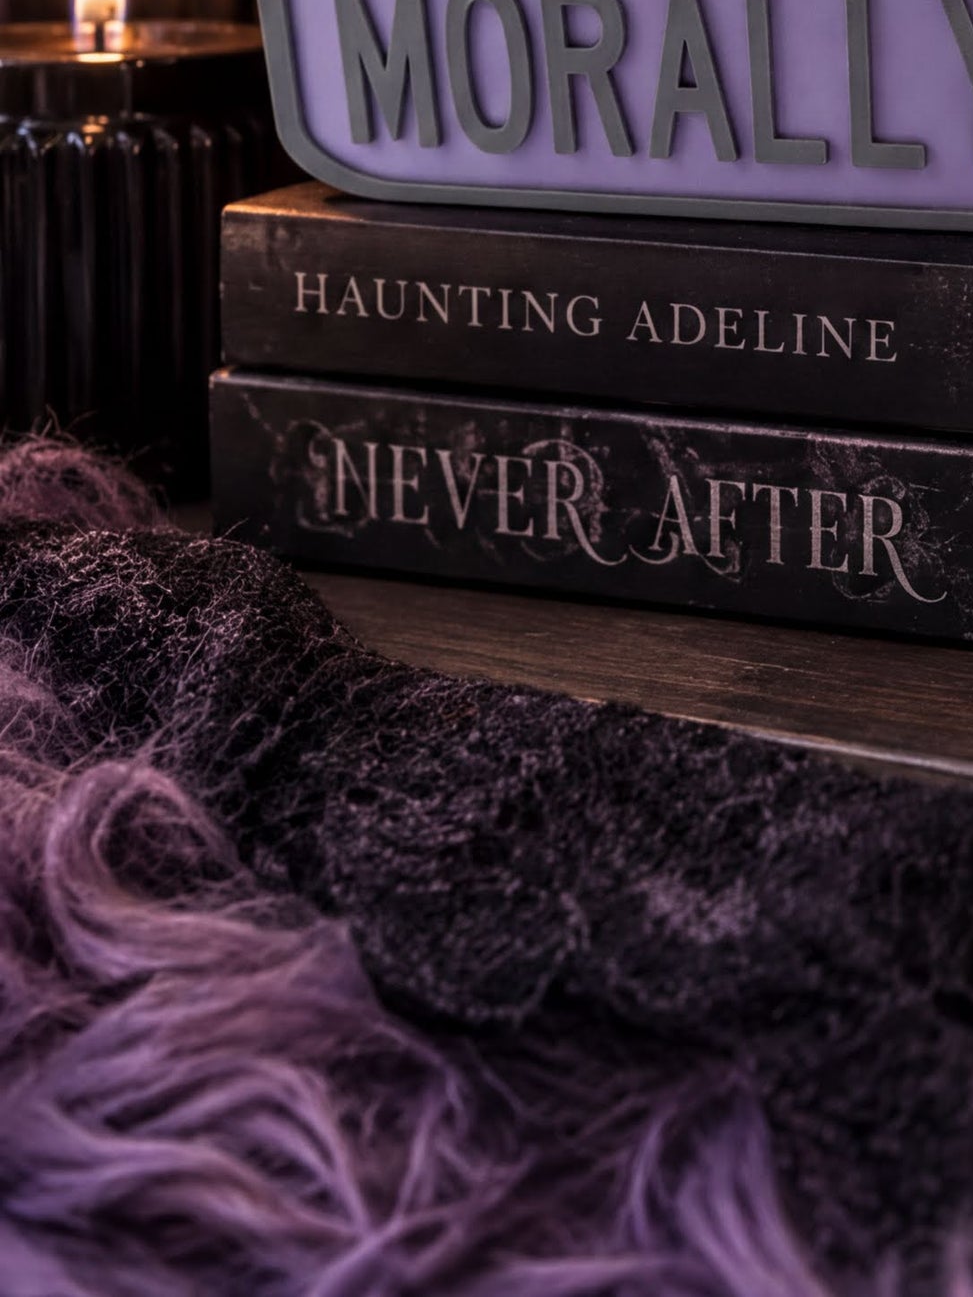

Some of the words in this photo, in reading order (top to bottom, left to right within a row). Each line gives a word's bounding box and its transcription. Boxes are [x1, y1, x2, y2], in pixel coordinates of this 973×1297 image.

[293, 272, 602, 338] HAUNTING
[625, 300, 898, 364] ADELINE
[331, 438, 628, 567] NEVER
[629, 475, 948, 603] AFTER
